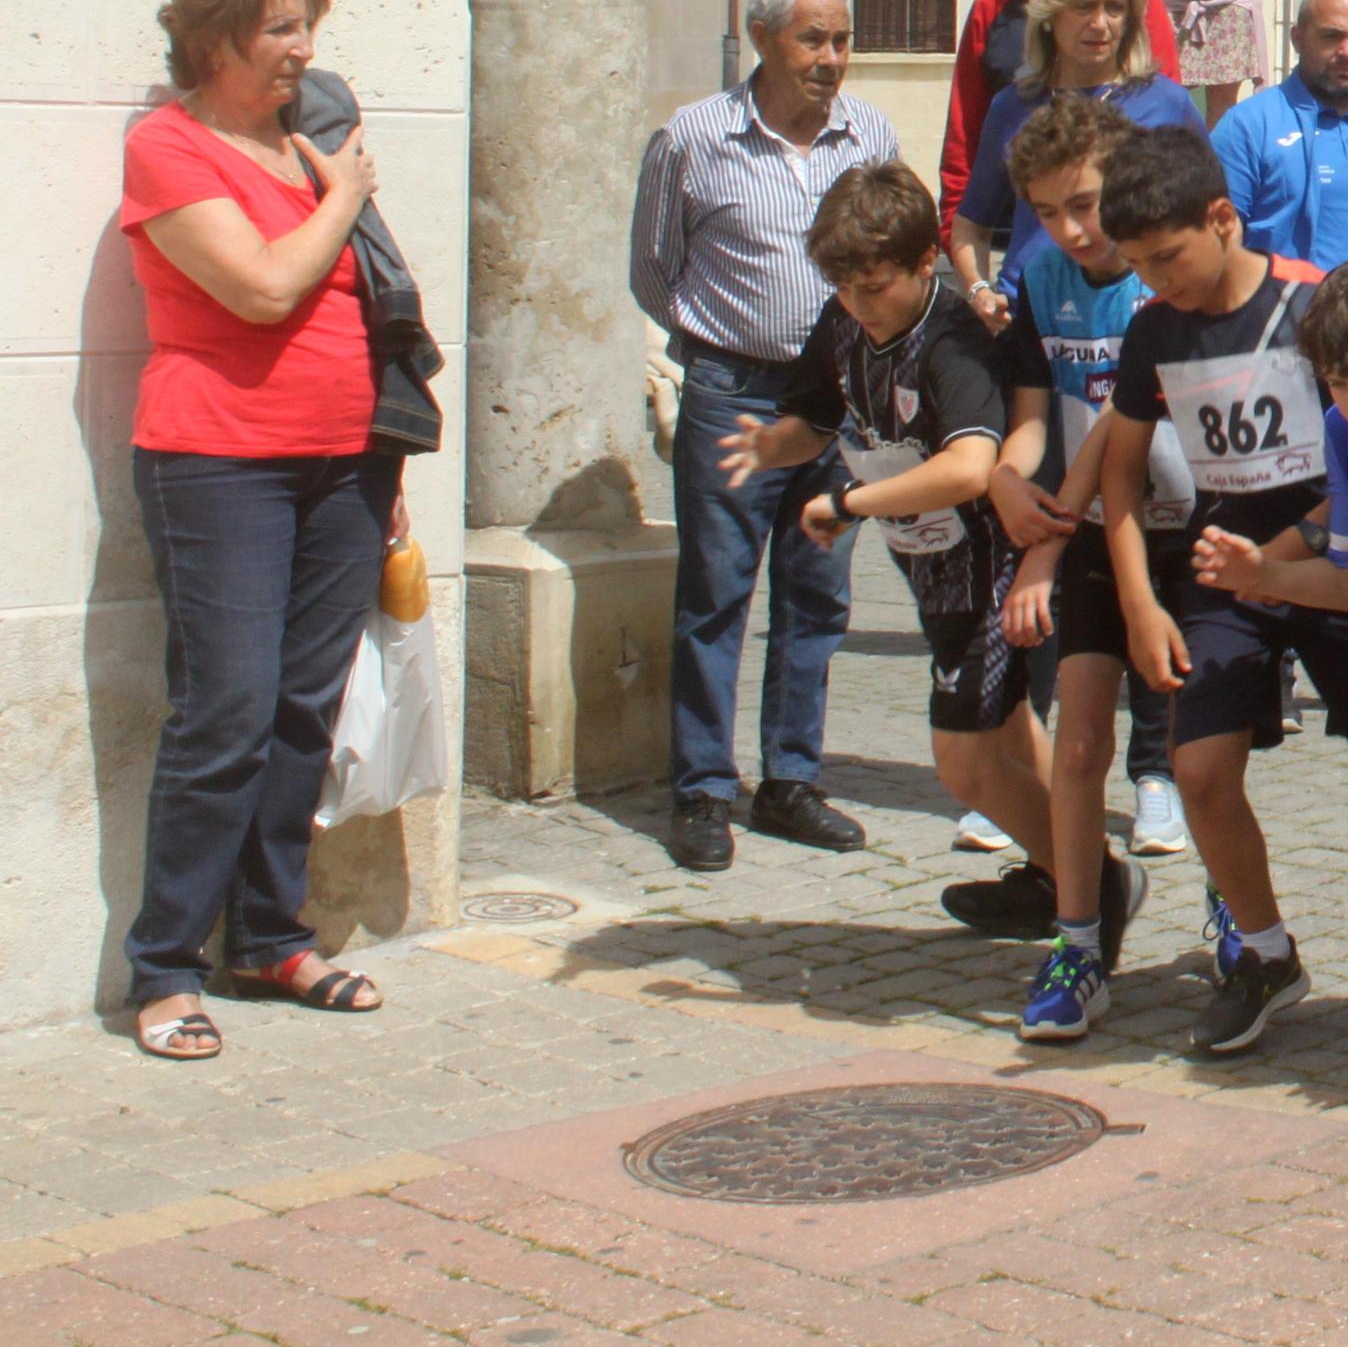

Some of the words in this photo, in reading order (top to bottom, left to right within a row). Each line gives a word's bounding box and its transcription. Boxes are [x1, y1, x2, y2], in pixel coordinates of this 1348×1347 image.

[1199, 395, 1289, 456] 862
[1207, 471, 1228, 486] Caja
[1230, 469, 1272, 486] España
